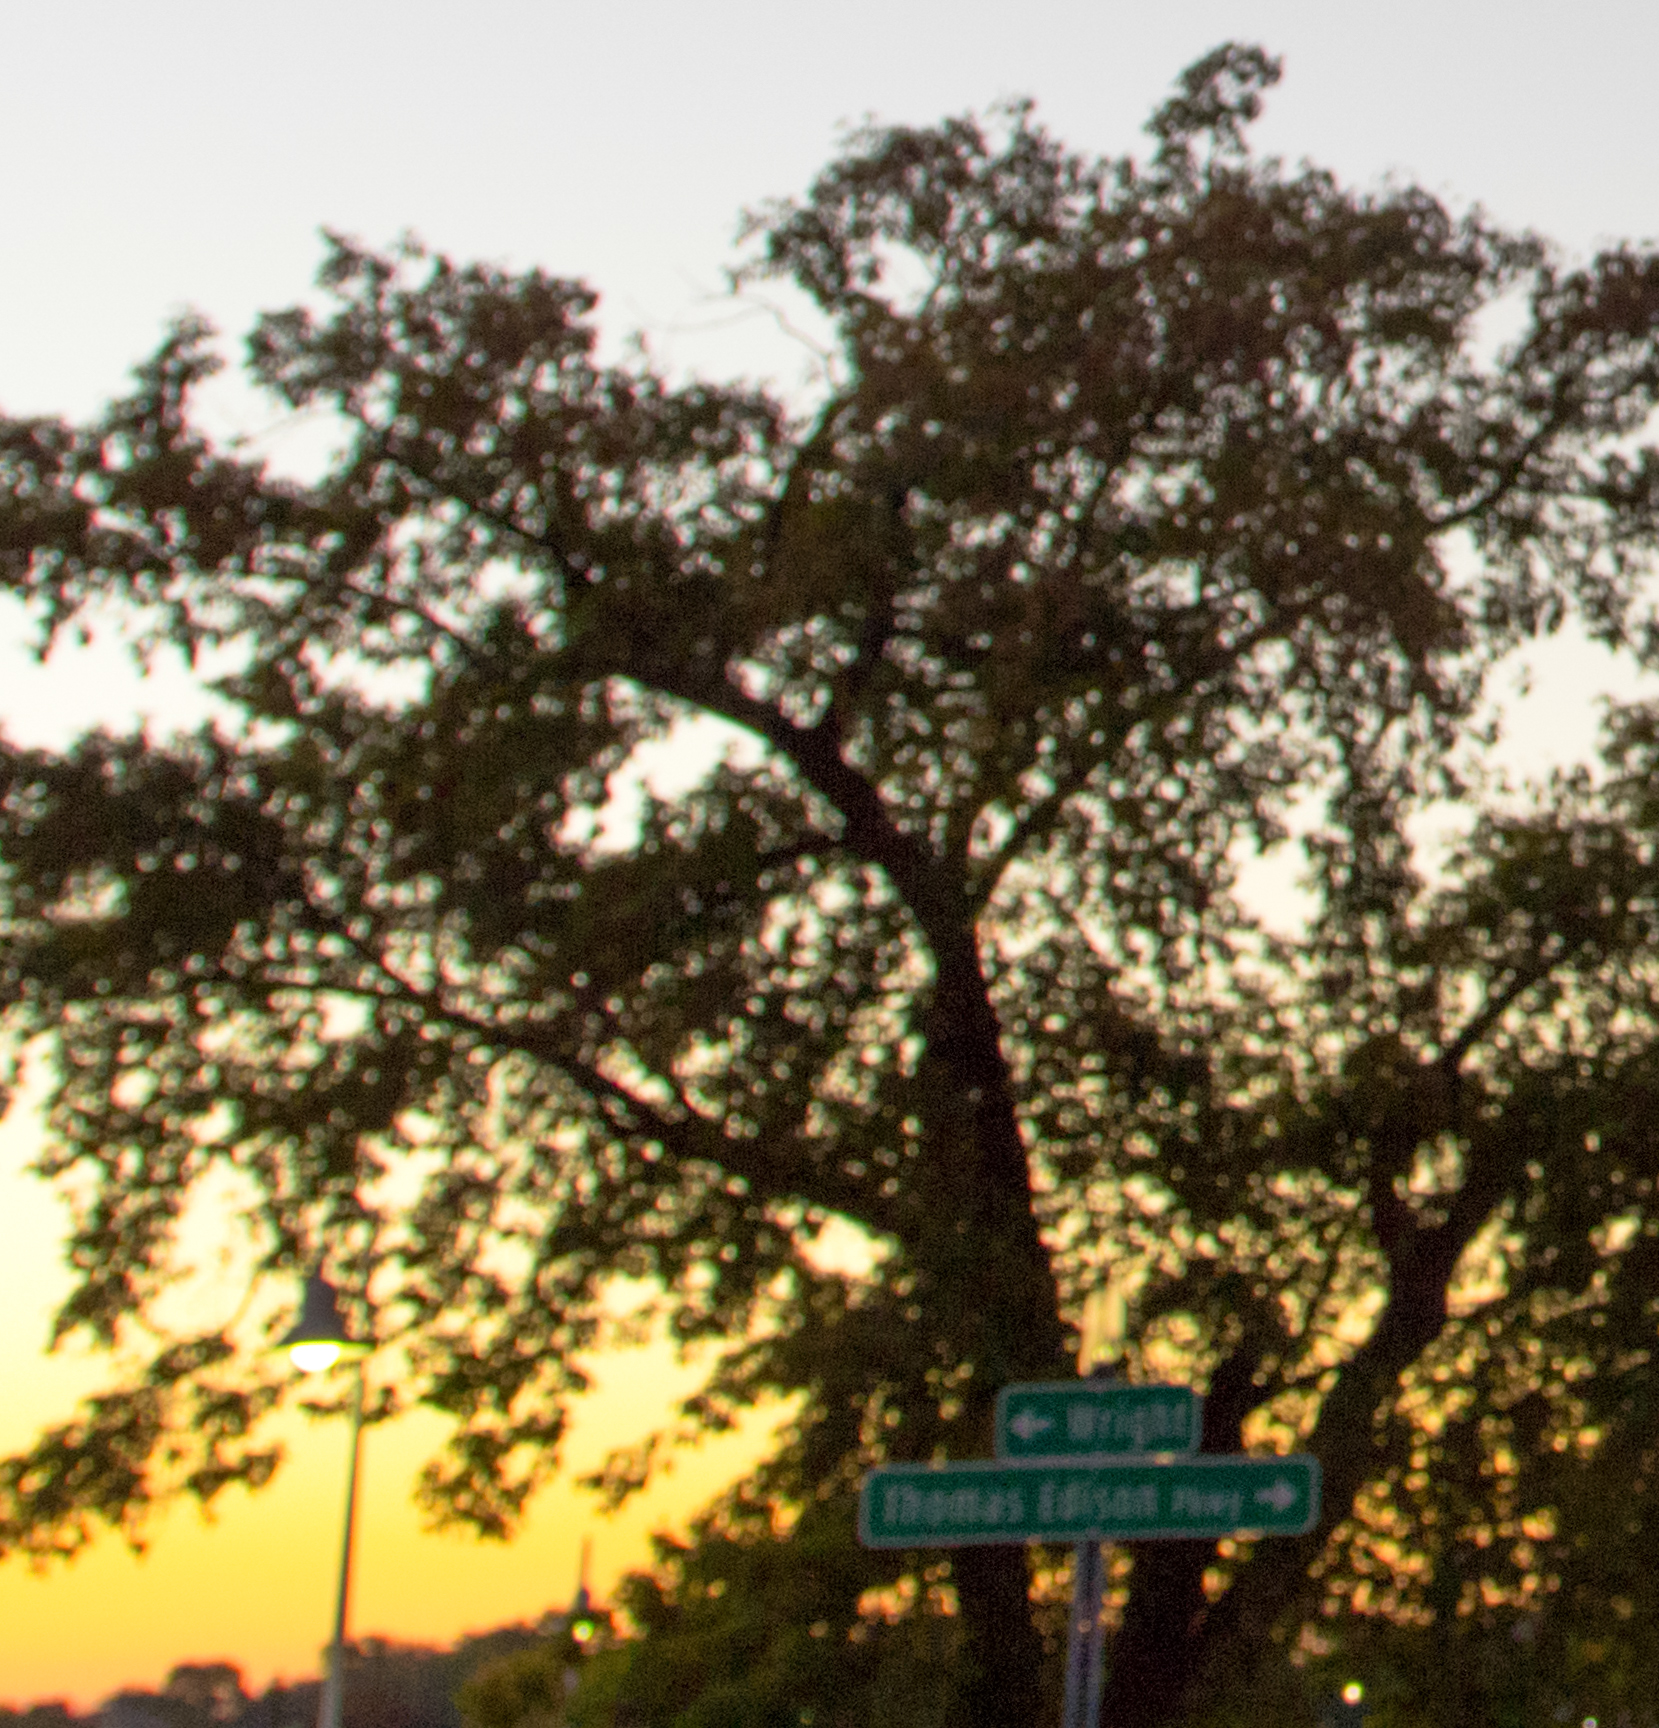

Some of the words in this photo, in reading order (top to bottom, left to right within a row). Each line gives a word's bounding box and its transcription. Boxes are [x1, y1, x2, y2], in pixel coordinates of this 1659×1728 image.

[1067, 1402, 1187, 1451] Wright
[884, 1485, 1024, 1525] Thomas
[1037, 1479, 1158, 1522] Edison
